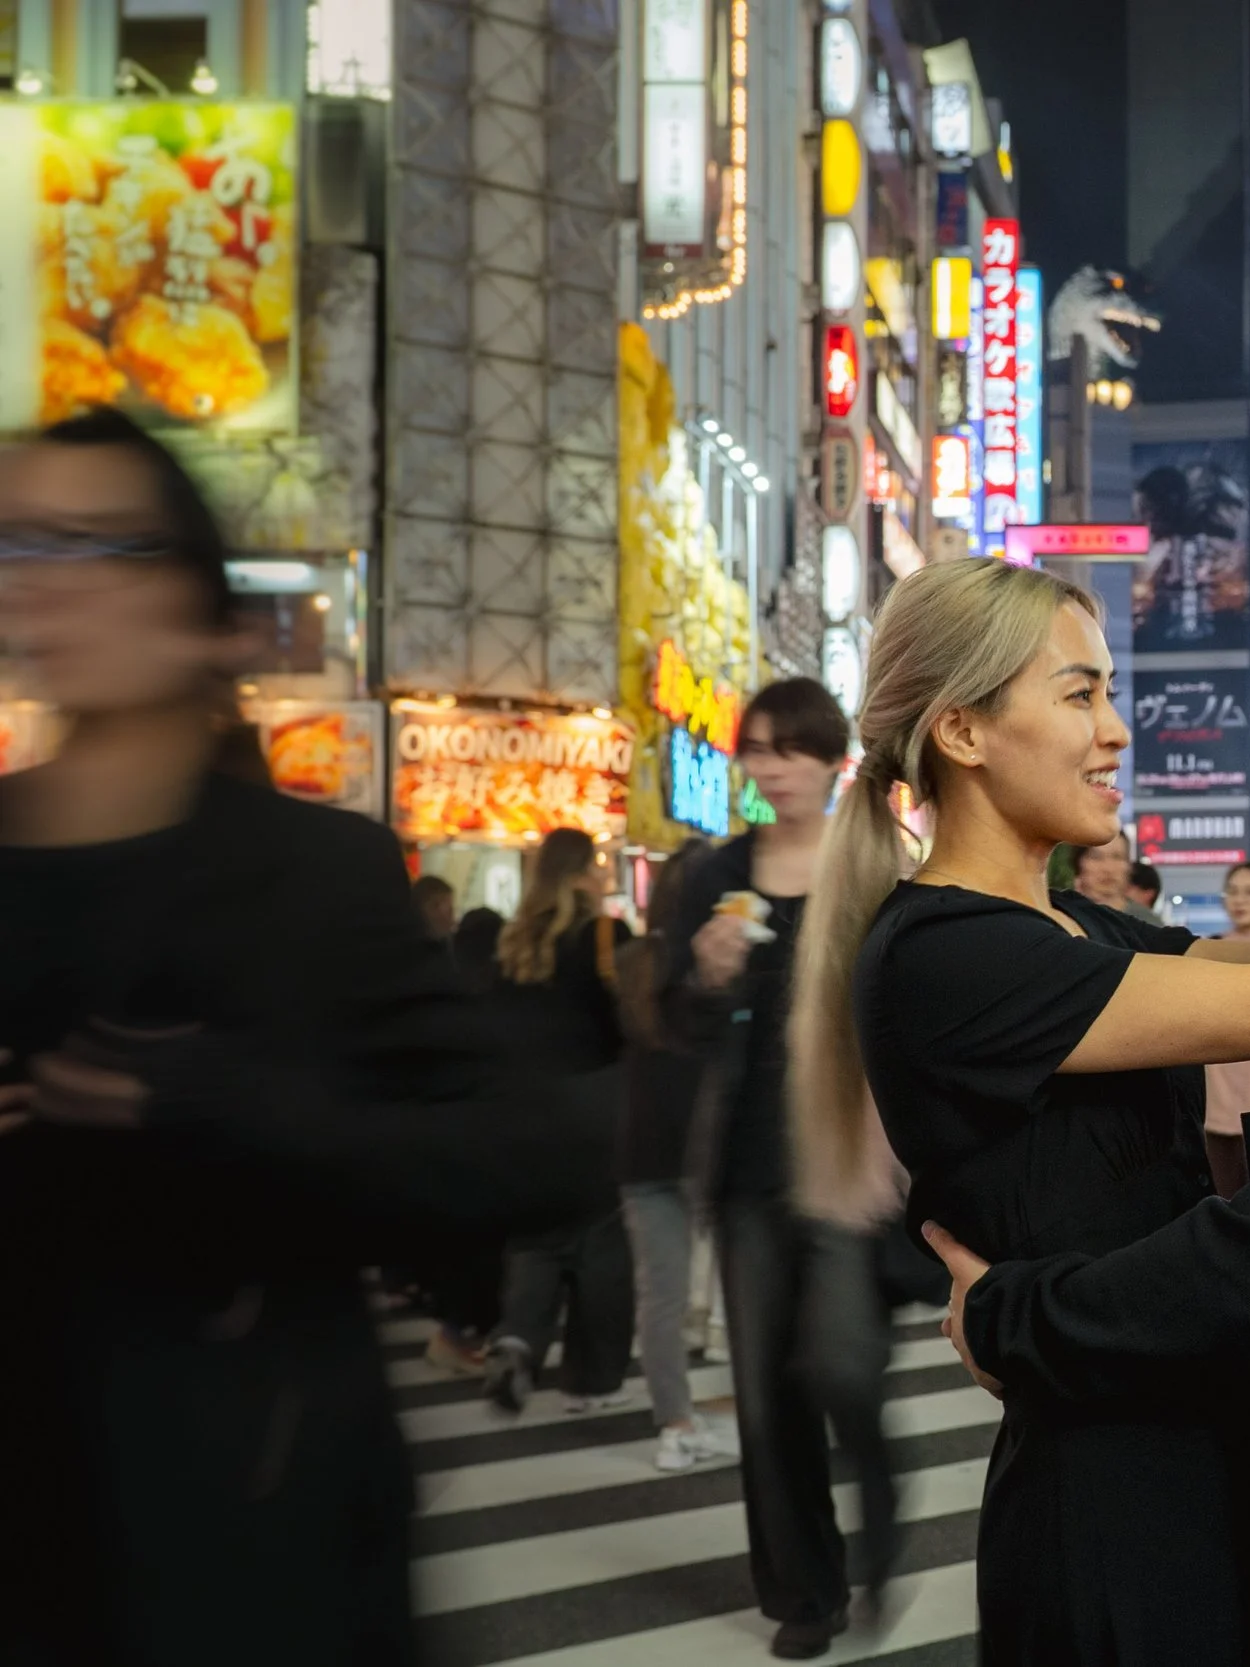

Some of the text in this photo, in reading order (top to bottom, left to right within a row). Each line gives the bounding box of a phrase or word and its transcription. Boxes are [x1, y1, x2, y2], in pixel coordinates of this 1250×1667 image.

[1134, 693, 1249, 731] ヴェノム
[398, 722, 635, 774] OKONOMIYAKI
[413, 763, 614, 810] お好み焼き
